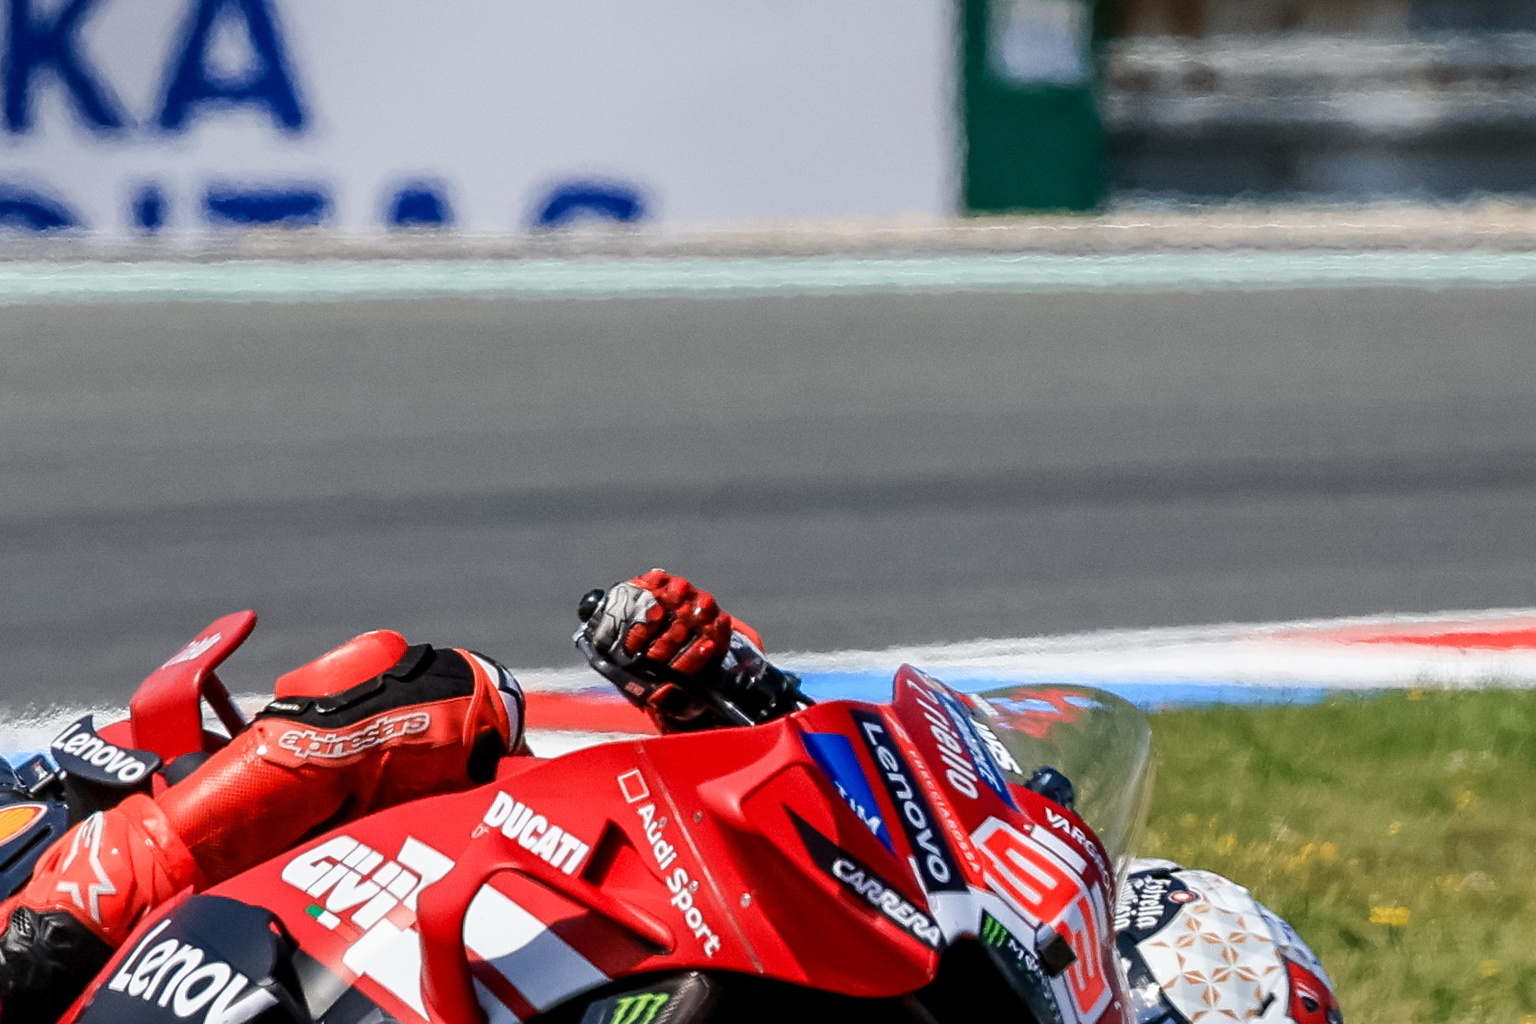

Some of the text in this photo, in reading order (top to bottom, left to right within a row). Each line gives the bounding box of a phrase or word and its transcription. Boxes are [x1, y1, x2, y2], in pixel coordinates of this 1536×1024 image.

[51, 722, 146, 783] Lenovo
[279, 712, 432, 760] alpinestars
[482, 790, 591, 876] DUCATI
[861, 720, 952, 884] Lenovo
[637, 803, 722, 958] Audi Sport
[831, 857, 941, 948] CARRERA
[1136, 875, 1172, 930] Estrella
